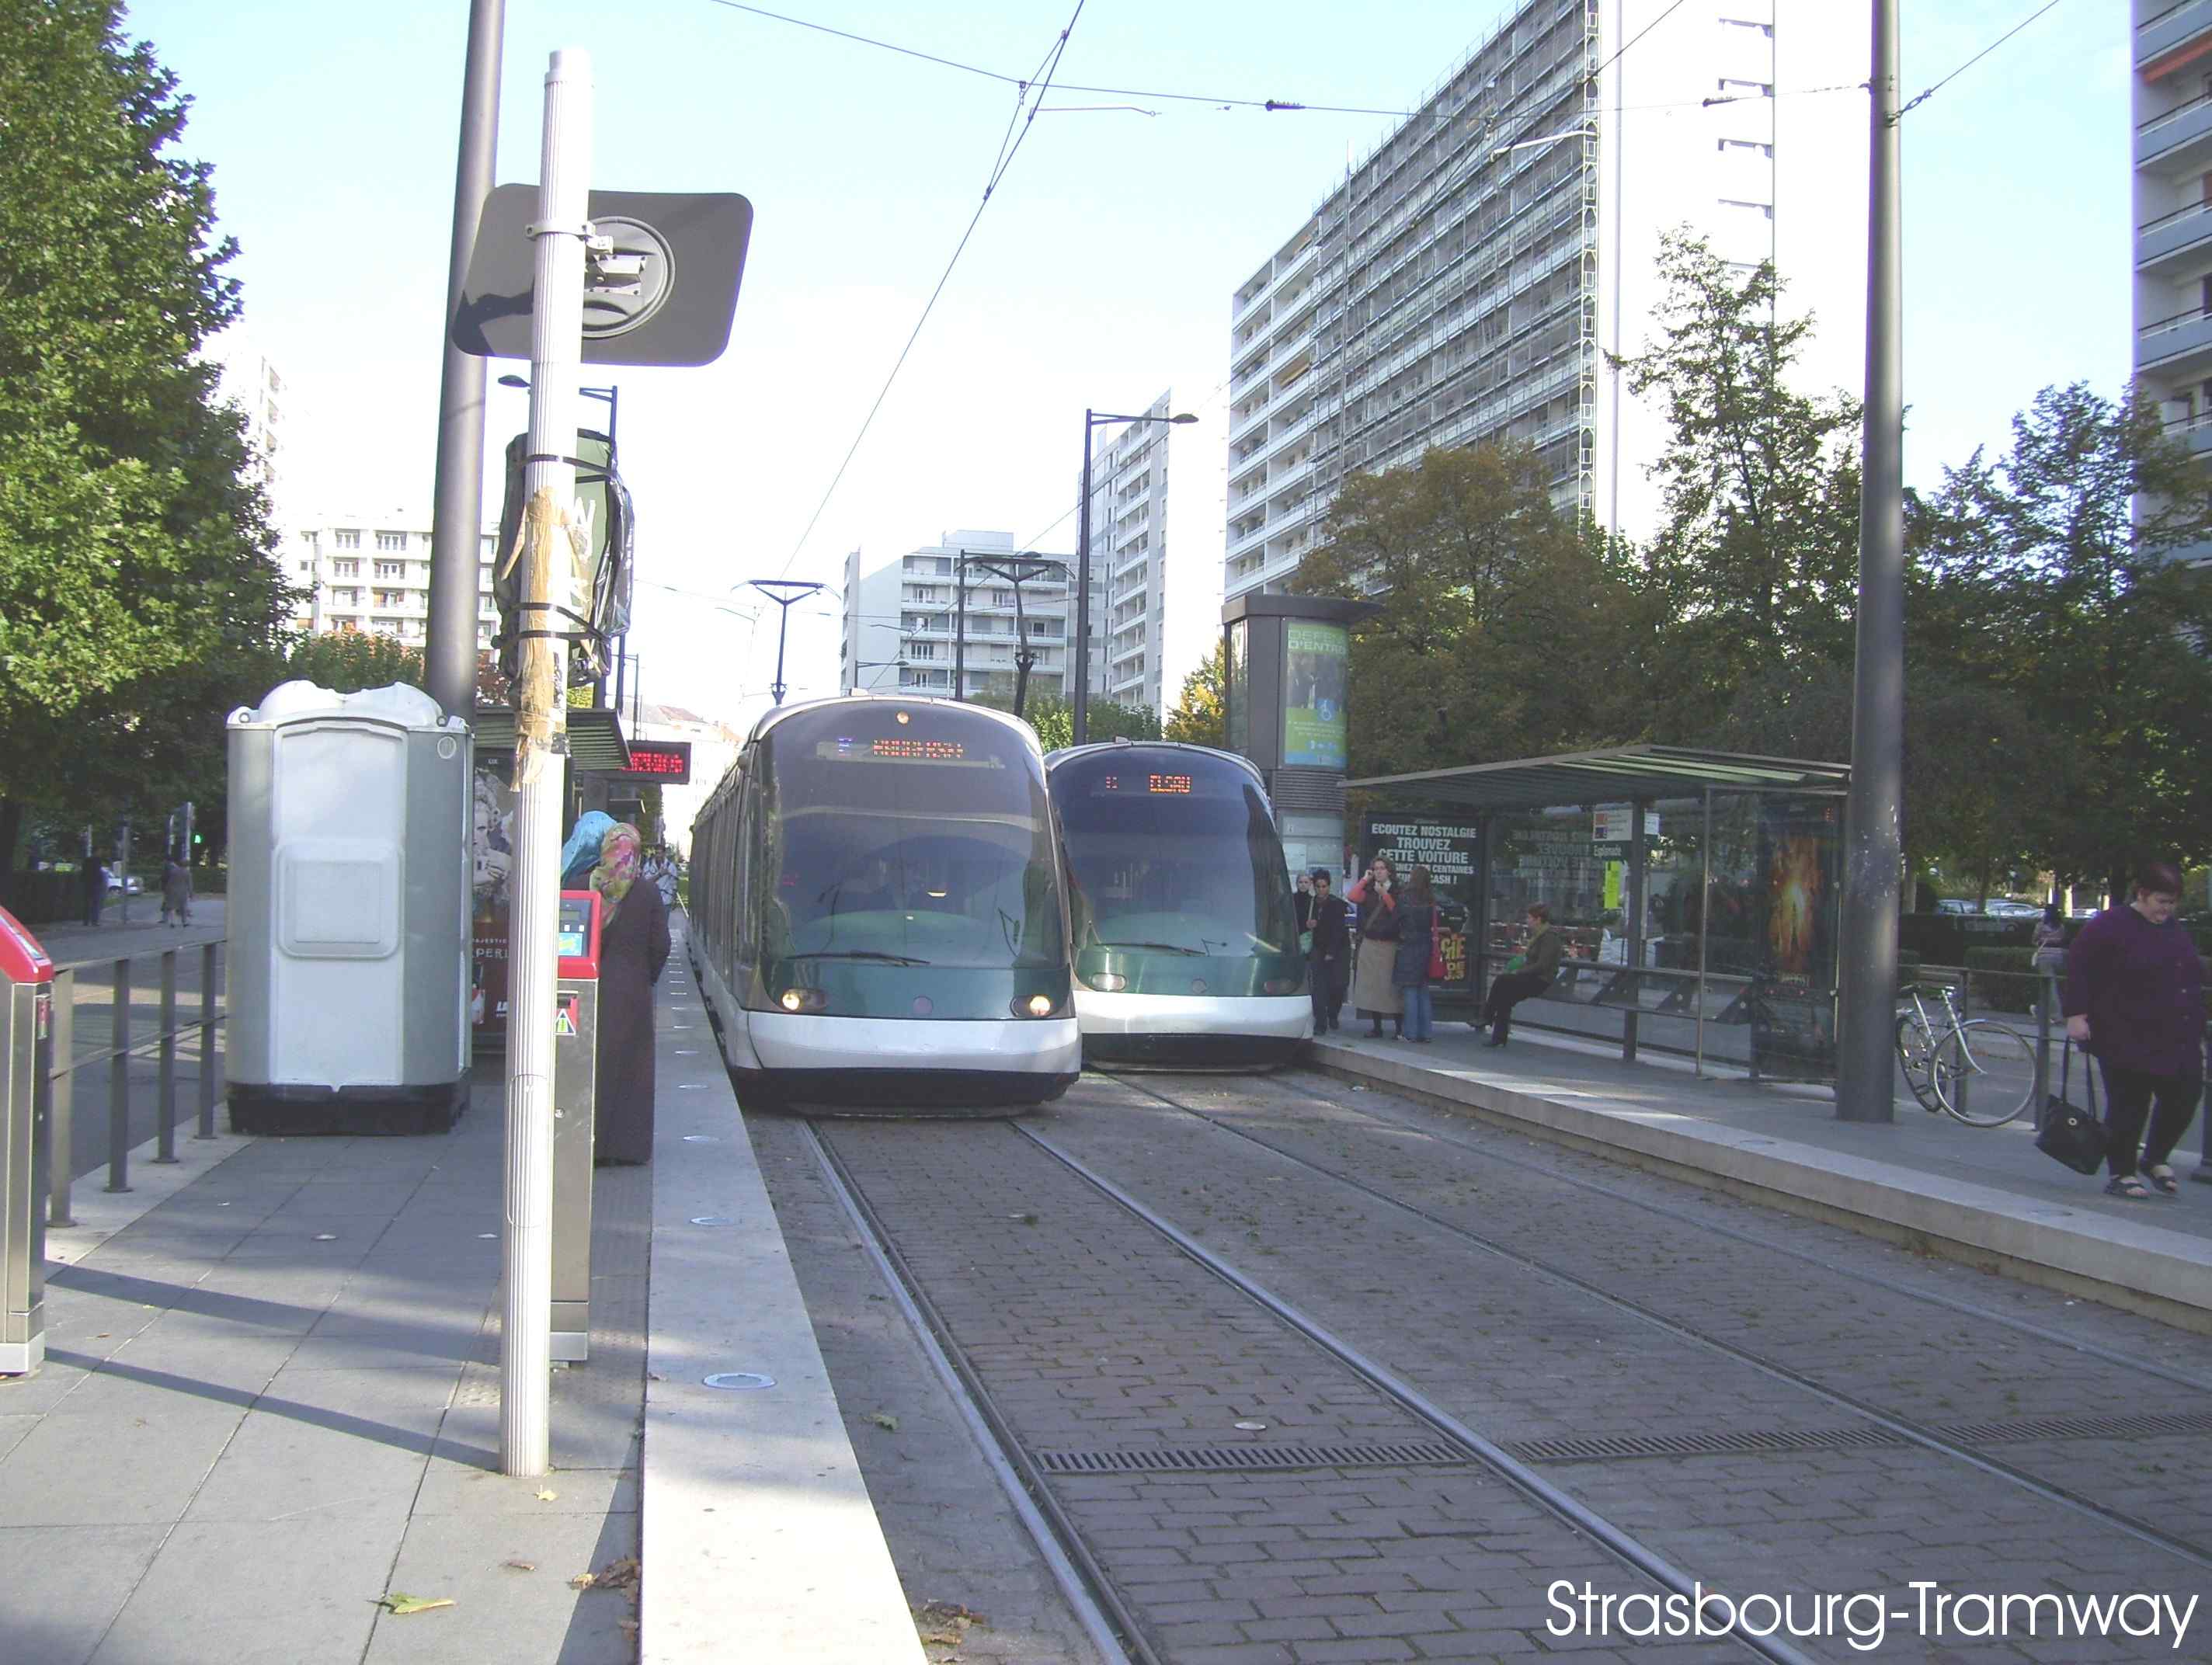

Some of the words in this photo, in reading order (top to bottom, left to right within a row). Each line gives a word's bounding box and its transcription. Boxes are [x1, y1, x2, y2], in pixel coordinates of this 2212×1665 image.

[1372, 823, 1417, 836] ECOUTEZ
[1421, 826, 1477, 838] NOSTALGIE
[1396, 836, 1451, 850] TROUVEZ
[1379, 848, 1415, 862] CETTE
[1418, 850, 1469, 864] VOITURE
[1431, 865, 1474, 874] CENTAINES
